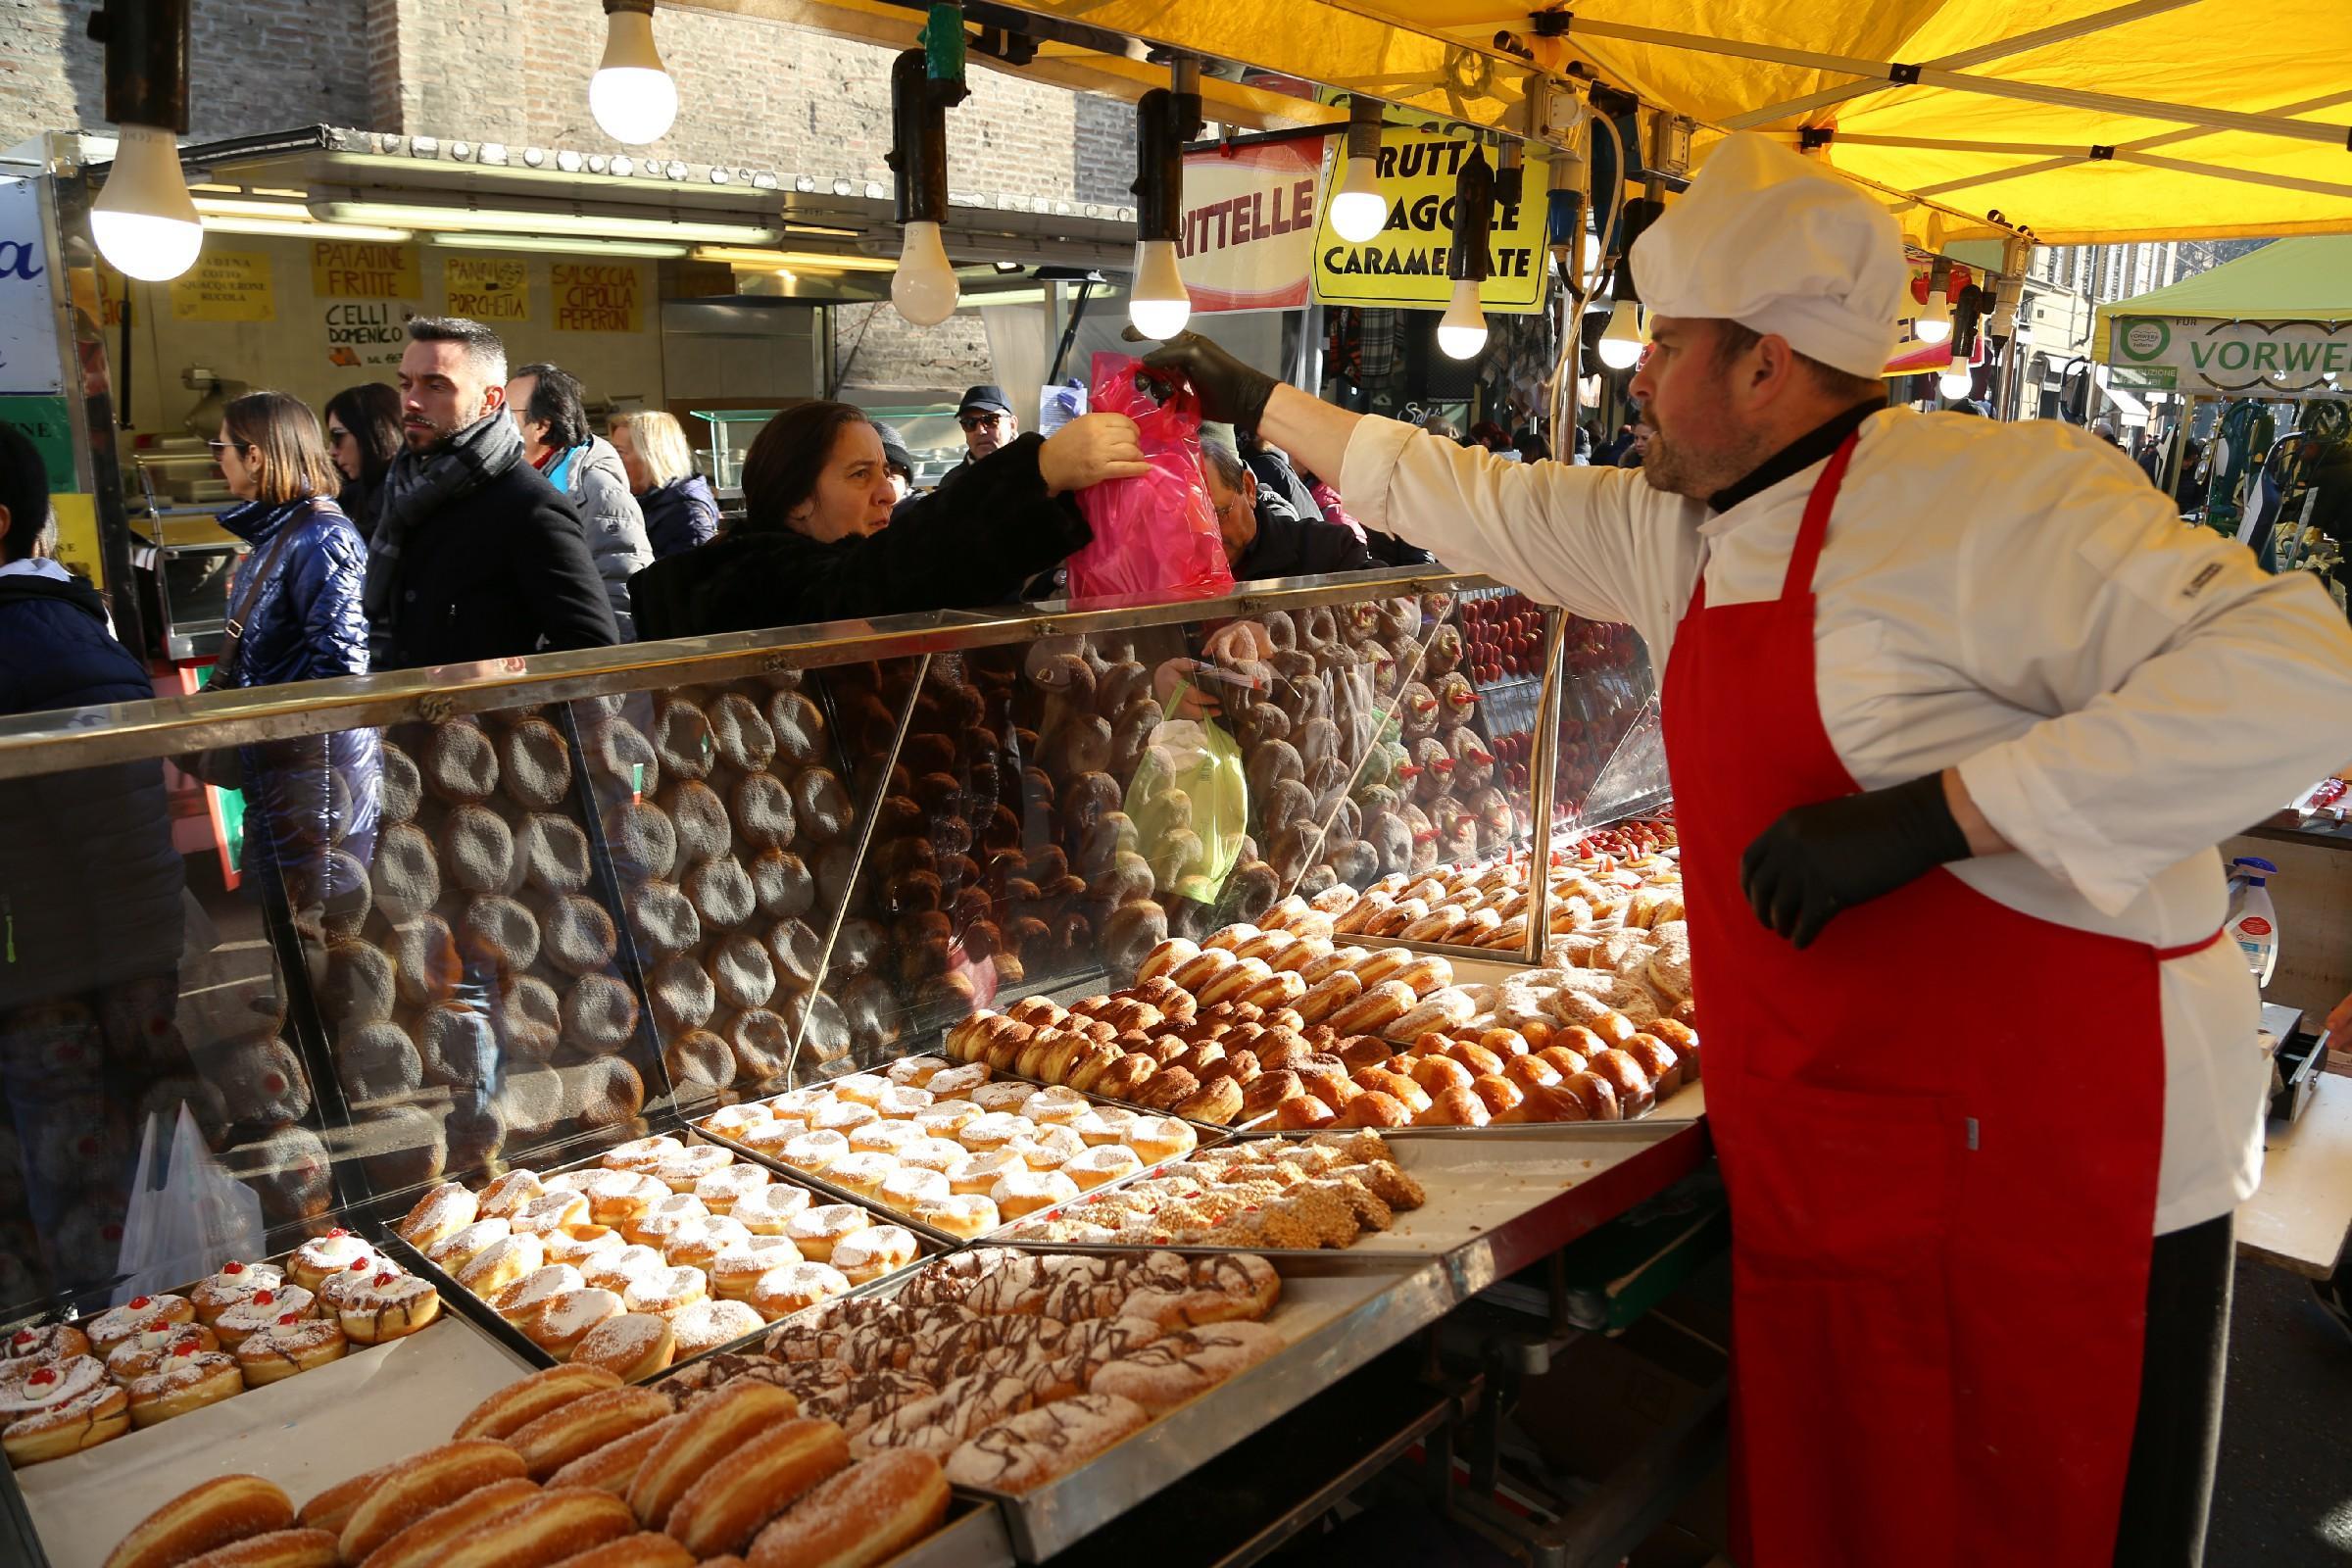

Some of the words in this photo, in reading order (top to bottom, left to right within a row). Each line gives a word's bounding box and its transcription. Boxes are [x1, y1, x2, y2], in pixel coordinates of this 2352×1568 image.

[1376, 140, 1467, 178] RUTT
[316, 242, 406, 270] PATATINE
[328, 270, 398, 297] FRITTE
[552, 265, 637, 287] SALSICCIA
[448, 292, 526, 318] PORCHETTA
[566, 285, 634, 309] CIPOLLA
[325, 303, 388, 325] CELLI
[328, 326, 403, 344] DOMENICO
[2190, 341, 2352, 372] VORWE
